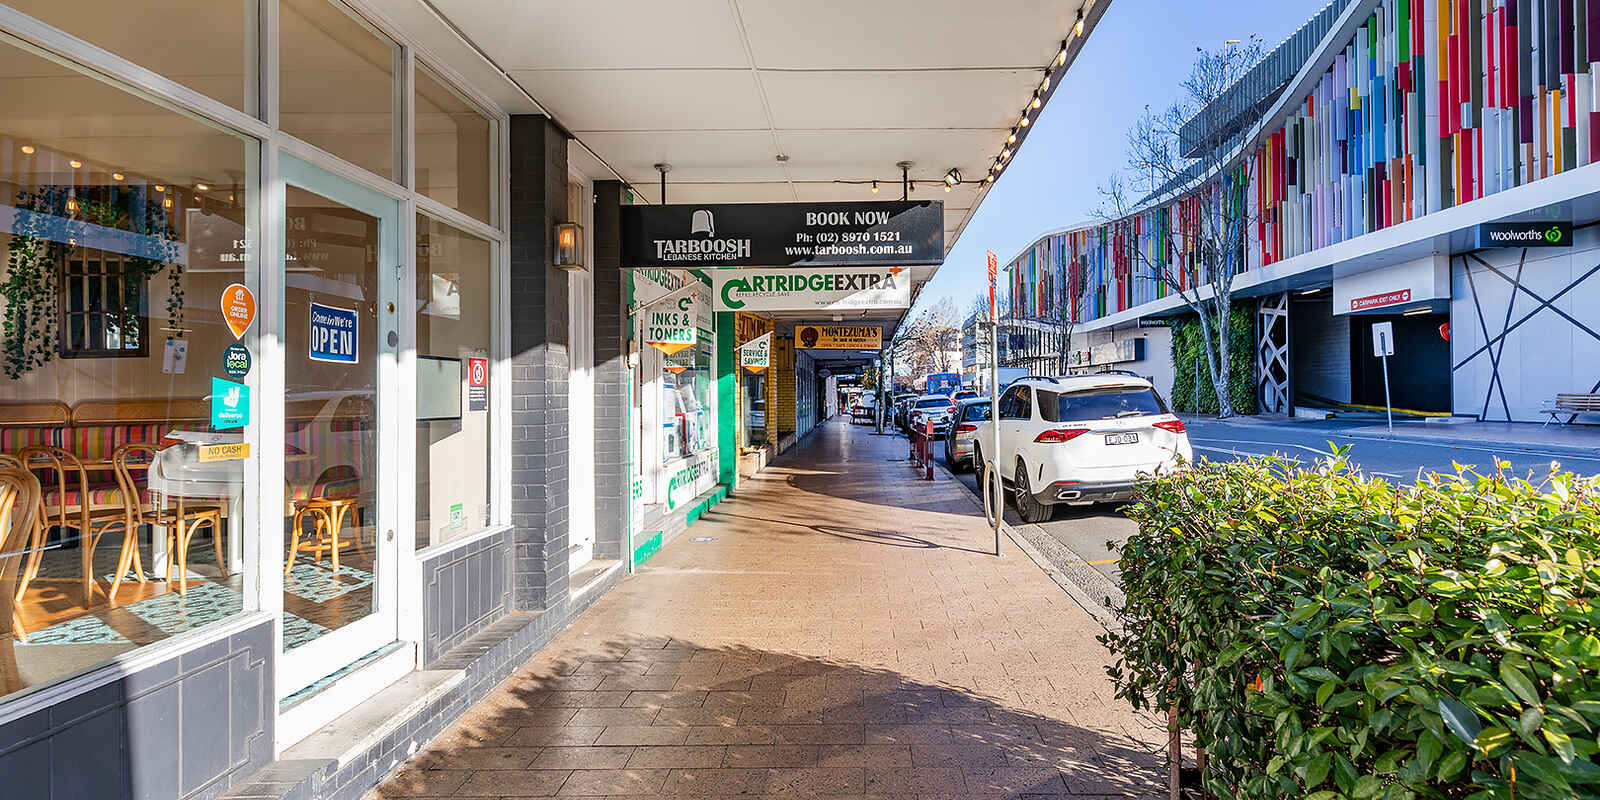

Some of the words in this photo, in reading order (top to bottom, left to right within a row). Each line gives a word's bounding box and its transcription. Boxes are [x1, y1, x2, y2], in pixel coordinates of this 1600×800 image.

[806, 211, 850, 226] BOOK
[855, 211, 890, 225] NOW
[796, 232, 813, 243] Ph:
[816, 232, 839, 244] (02)
[841, 232, 870, 242] 8970
[873, 231, 900, 242] 1521
[1489, 229, 1543, 241] woolworths
[653, 238, 751, 259] TARBOOSH
[784, 243, 913, 256] www.tarboosh.com.au
[663, 253, 702, 261] LEBANESE
[703, 252, 737, 260] KITCHEN
[720, 273, 897, 310] CARTRIDGEEXTRA
[651, 312, 678, 326] INKS
[682, 313, 690, 326] &
[649, 327, 693, 341] TONERS
[821, 327, 878, 338] MONTEZUMA'S
[312, 325, 353, 355] OPEN
[227, 351, 247, 361] Jora
[743, 349, 764, 358] SERVICE
[226, 359, 248, 369] local
[208, 447, 220, 457] NO
[221, 445, 242, 455] CASH
